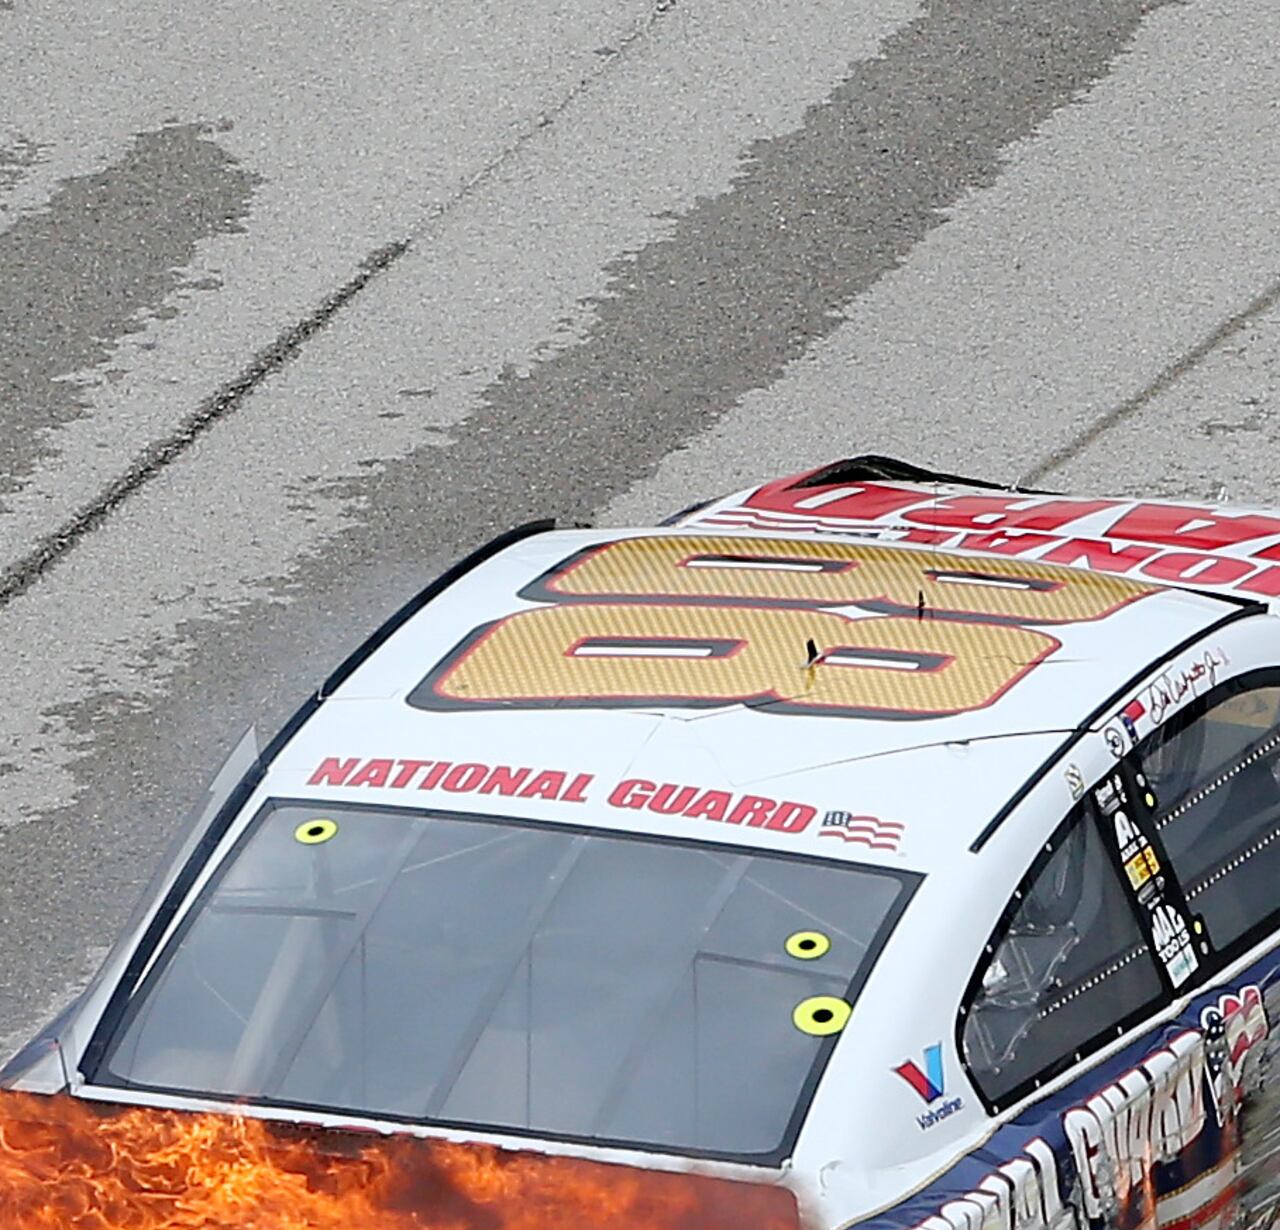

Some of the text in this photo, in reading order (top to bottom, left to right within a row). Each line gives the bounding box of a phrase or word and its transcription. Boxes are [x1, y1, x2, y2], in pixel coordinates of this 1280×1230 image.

[407, 535, 1172, 720] 88
[306, 757, 818, 834] NATIONAL GUARD
[1158, 929, 1191, 963] TOOLS
[916, 1097, 964, 1131] Valvoline
[1064, 1030, 1206, 1220] GUARD
